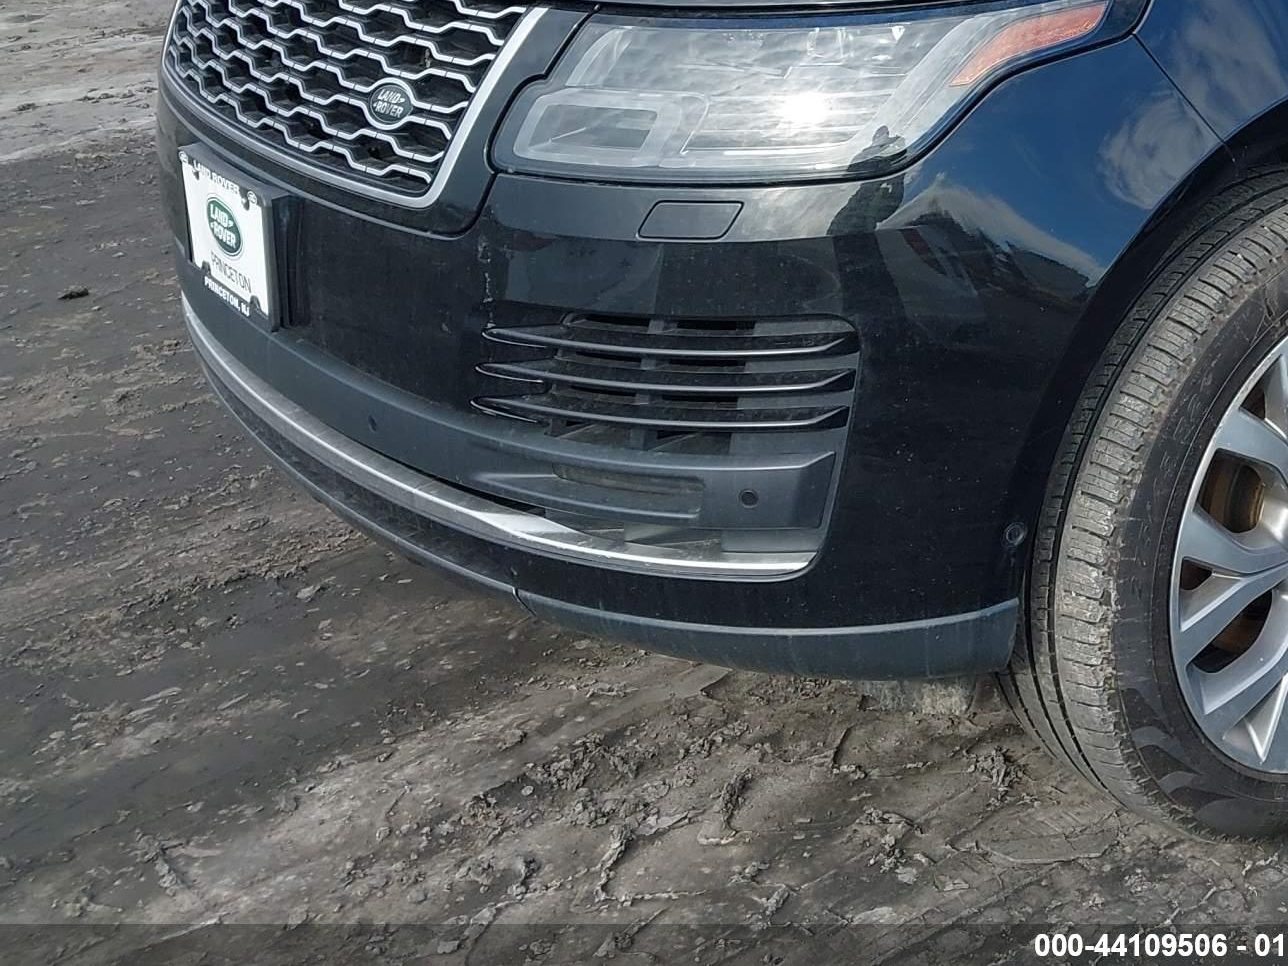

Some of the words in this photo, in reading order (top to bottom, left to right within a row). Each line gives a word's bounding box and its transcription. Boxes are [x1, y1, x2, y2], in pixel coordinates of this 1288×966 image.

[377, 88, 402, 104] LAND
[375, 100, 404, 118] ROVER
[209, 204, 229, 228] LAND
[212, 223, 238, 249] ROVER
[211, 252, 252, 293] PRINCETON
